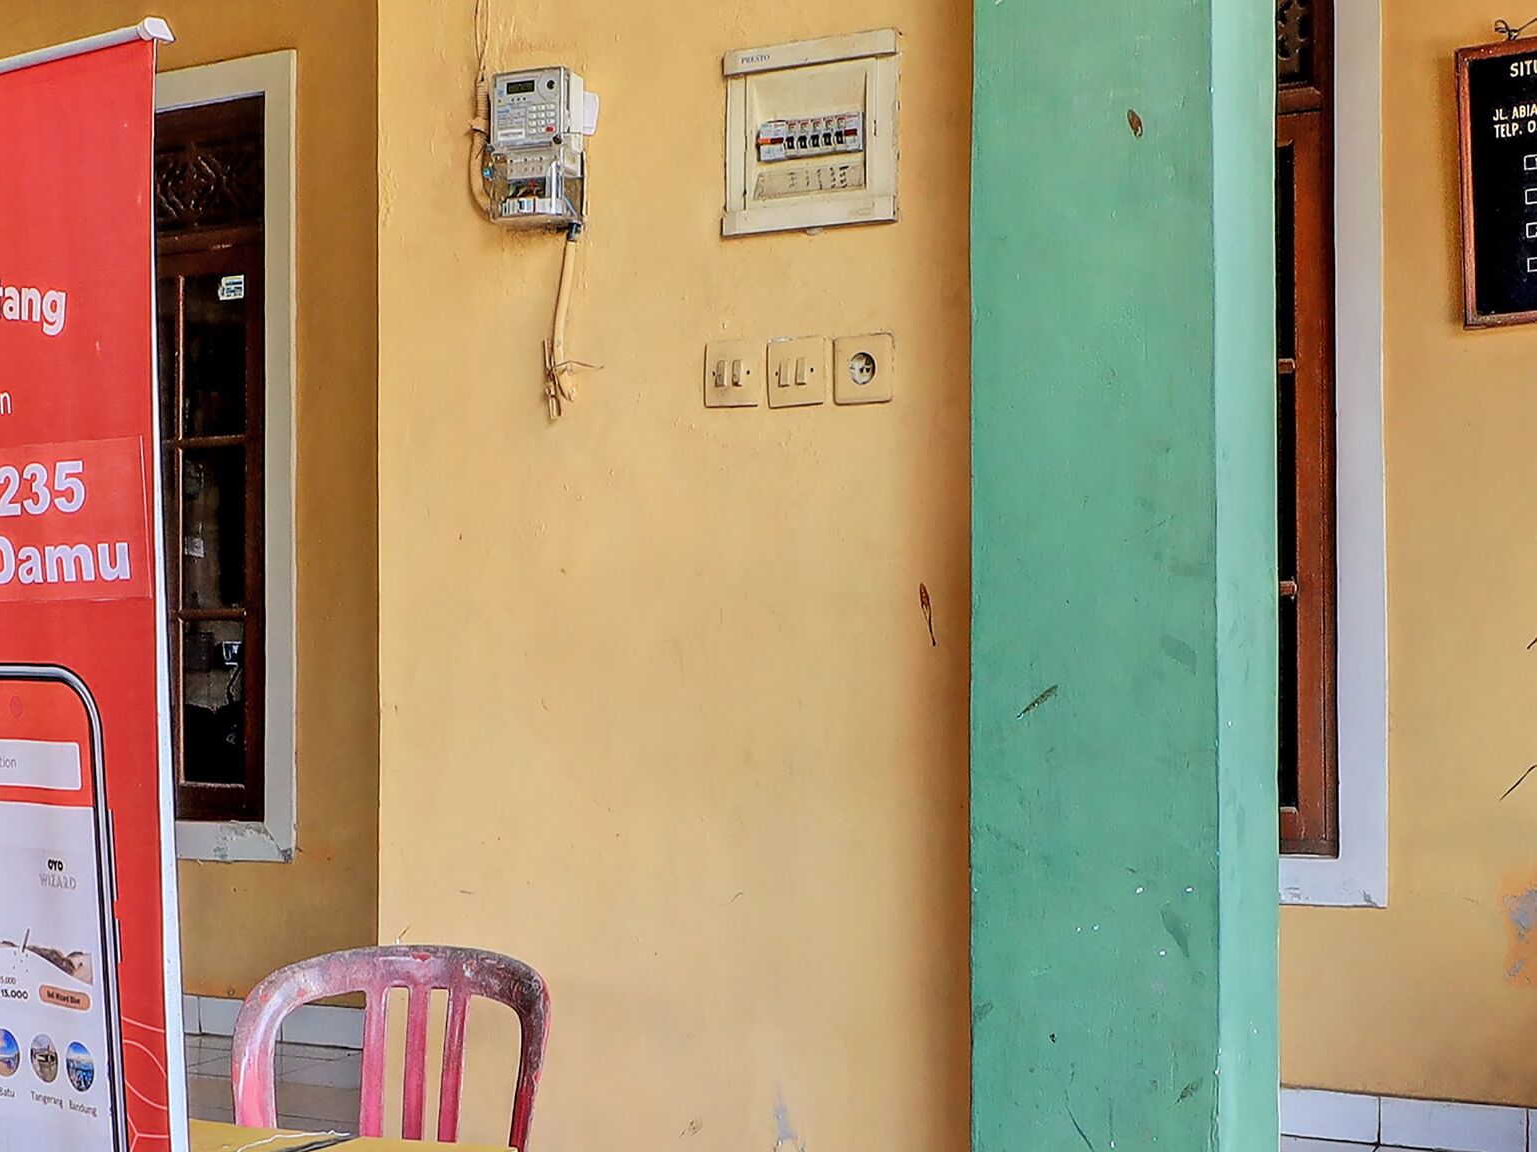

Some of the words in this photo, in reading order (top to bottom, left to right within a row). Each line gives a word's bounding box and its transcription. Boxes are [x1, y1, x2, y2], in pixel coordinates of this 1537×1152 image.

[741, 54, 770, 64] PRESTO
[1493, 108, 1508, 121] JL.
[1494, 122, 1522, 138] TELP.
[48, 859, 63, 871] OYO
[1, 989, 28, 999] 15.000
[30, 1091, 63, 1108] Tangerang
[69, 1100, 97, 1117] Bandung
